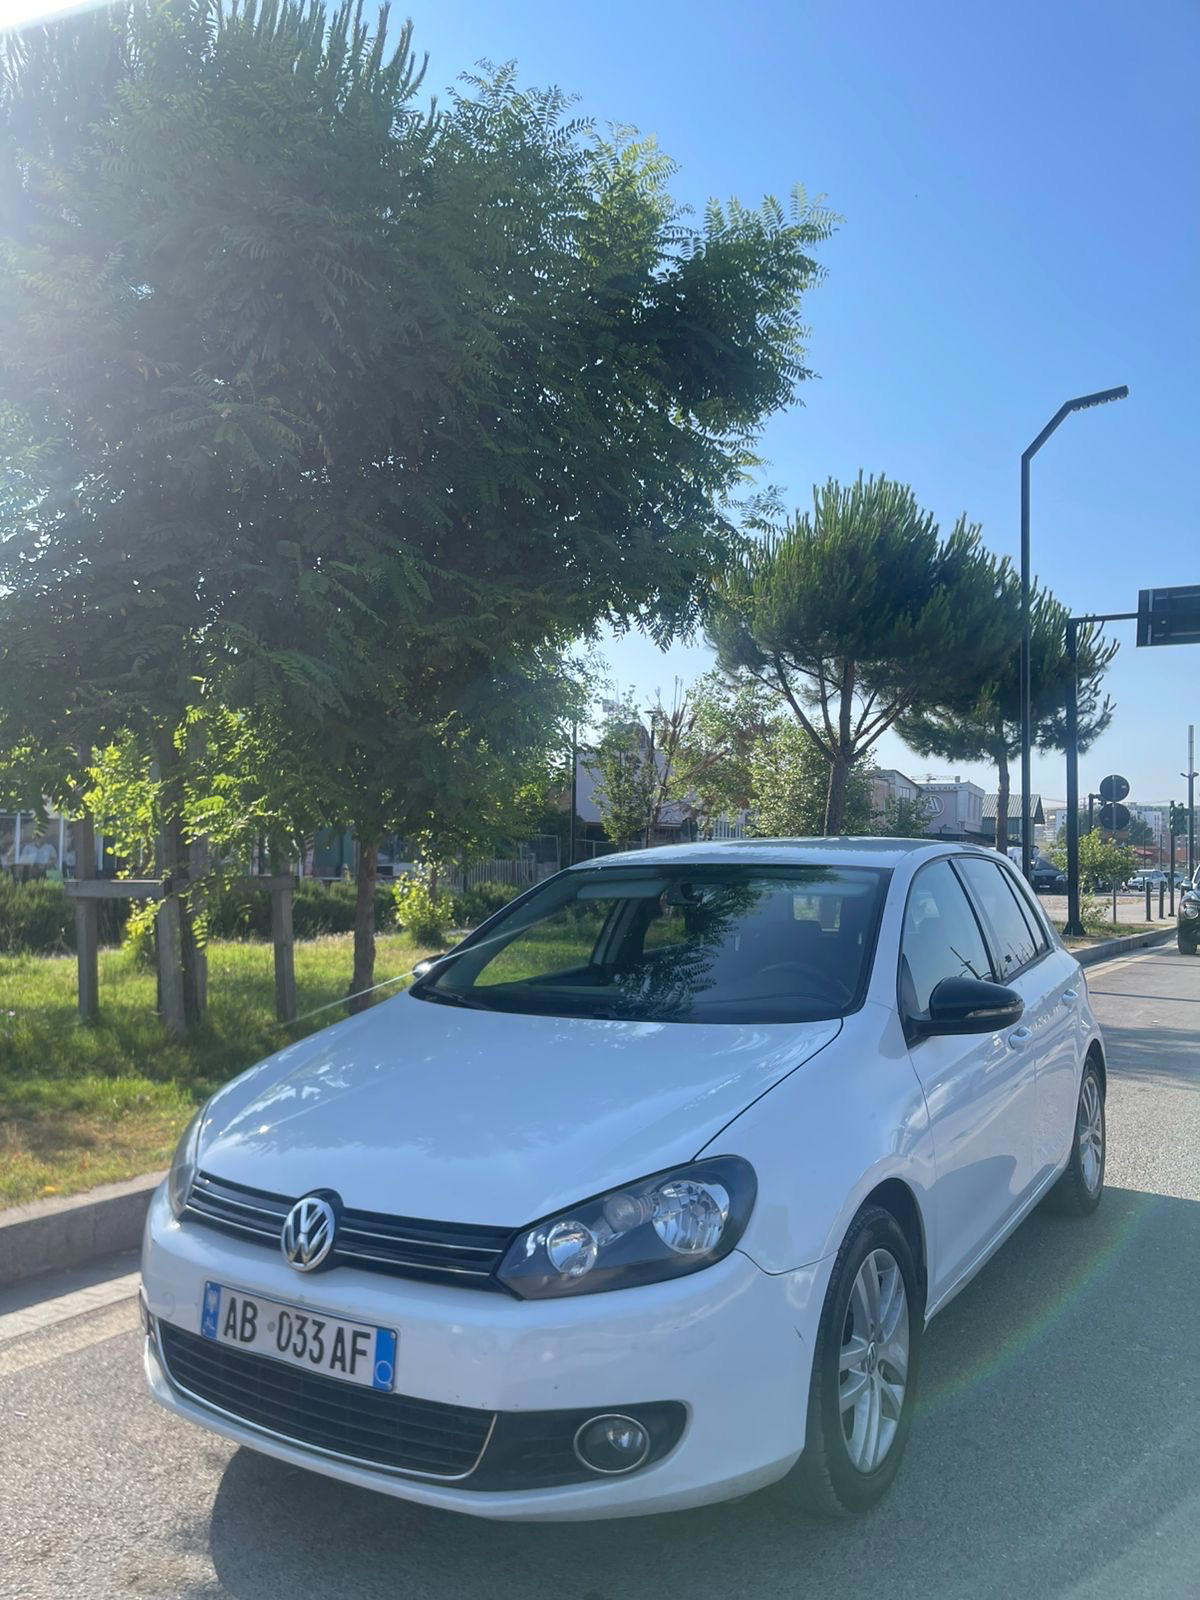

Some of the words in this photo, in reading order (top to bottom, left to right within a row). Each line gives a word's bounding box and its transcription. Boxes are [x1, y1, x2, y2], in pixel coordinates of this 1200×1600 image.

[224, 1297, 258, 1342] AB
[276, 1311, 326, 1364] 033
[329, 1327, 371, 1374] AF
